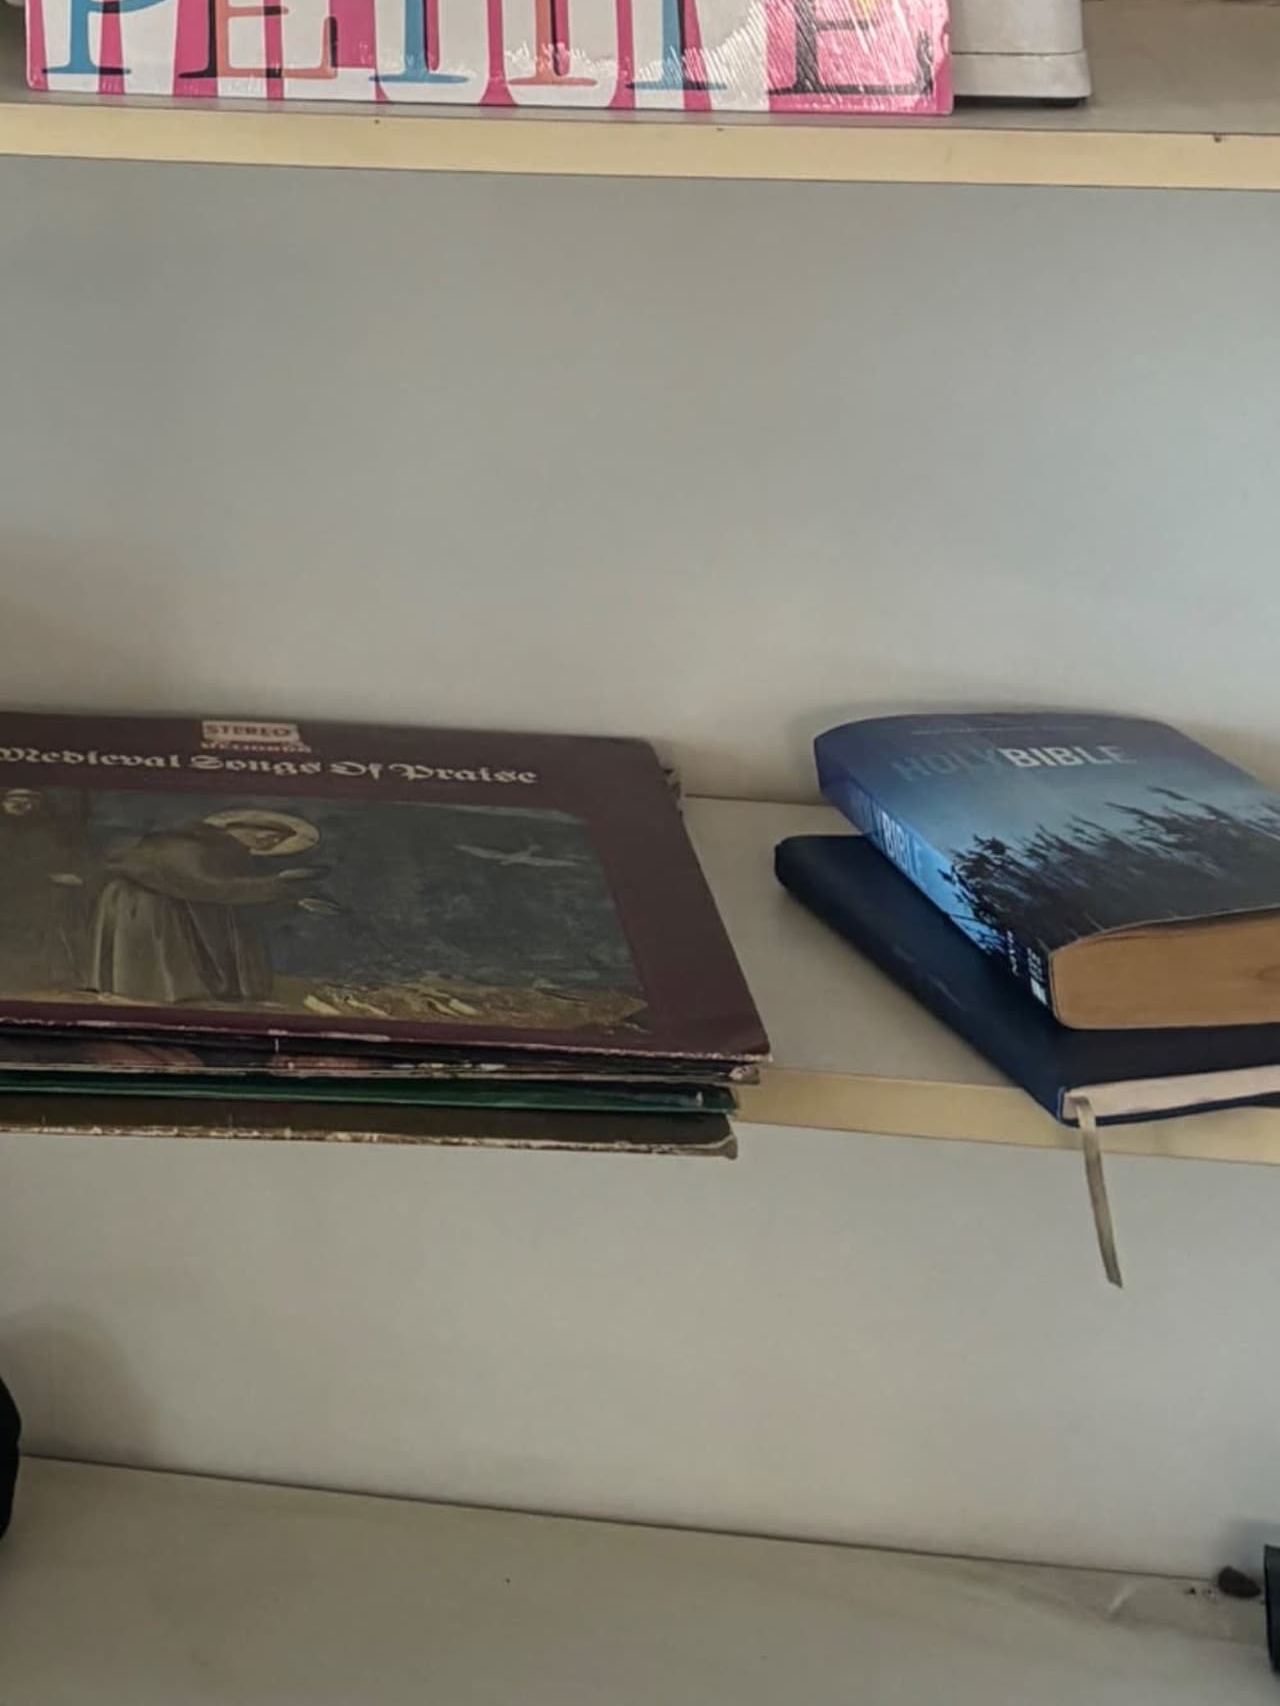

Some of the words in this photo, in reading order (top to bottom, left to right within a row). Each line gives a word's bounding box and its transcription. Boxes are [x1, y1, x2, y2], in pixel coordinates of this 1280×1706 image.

[206, 724, 290, 737] STEREO
[190, 754, 323, 776] Songs
[330, 760, 384, 780] Of
[389, 763, 538, 784] Praise
[892, 745, 1000, 782] HOLY
[998, 745, 1137, 768] BIBLE
